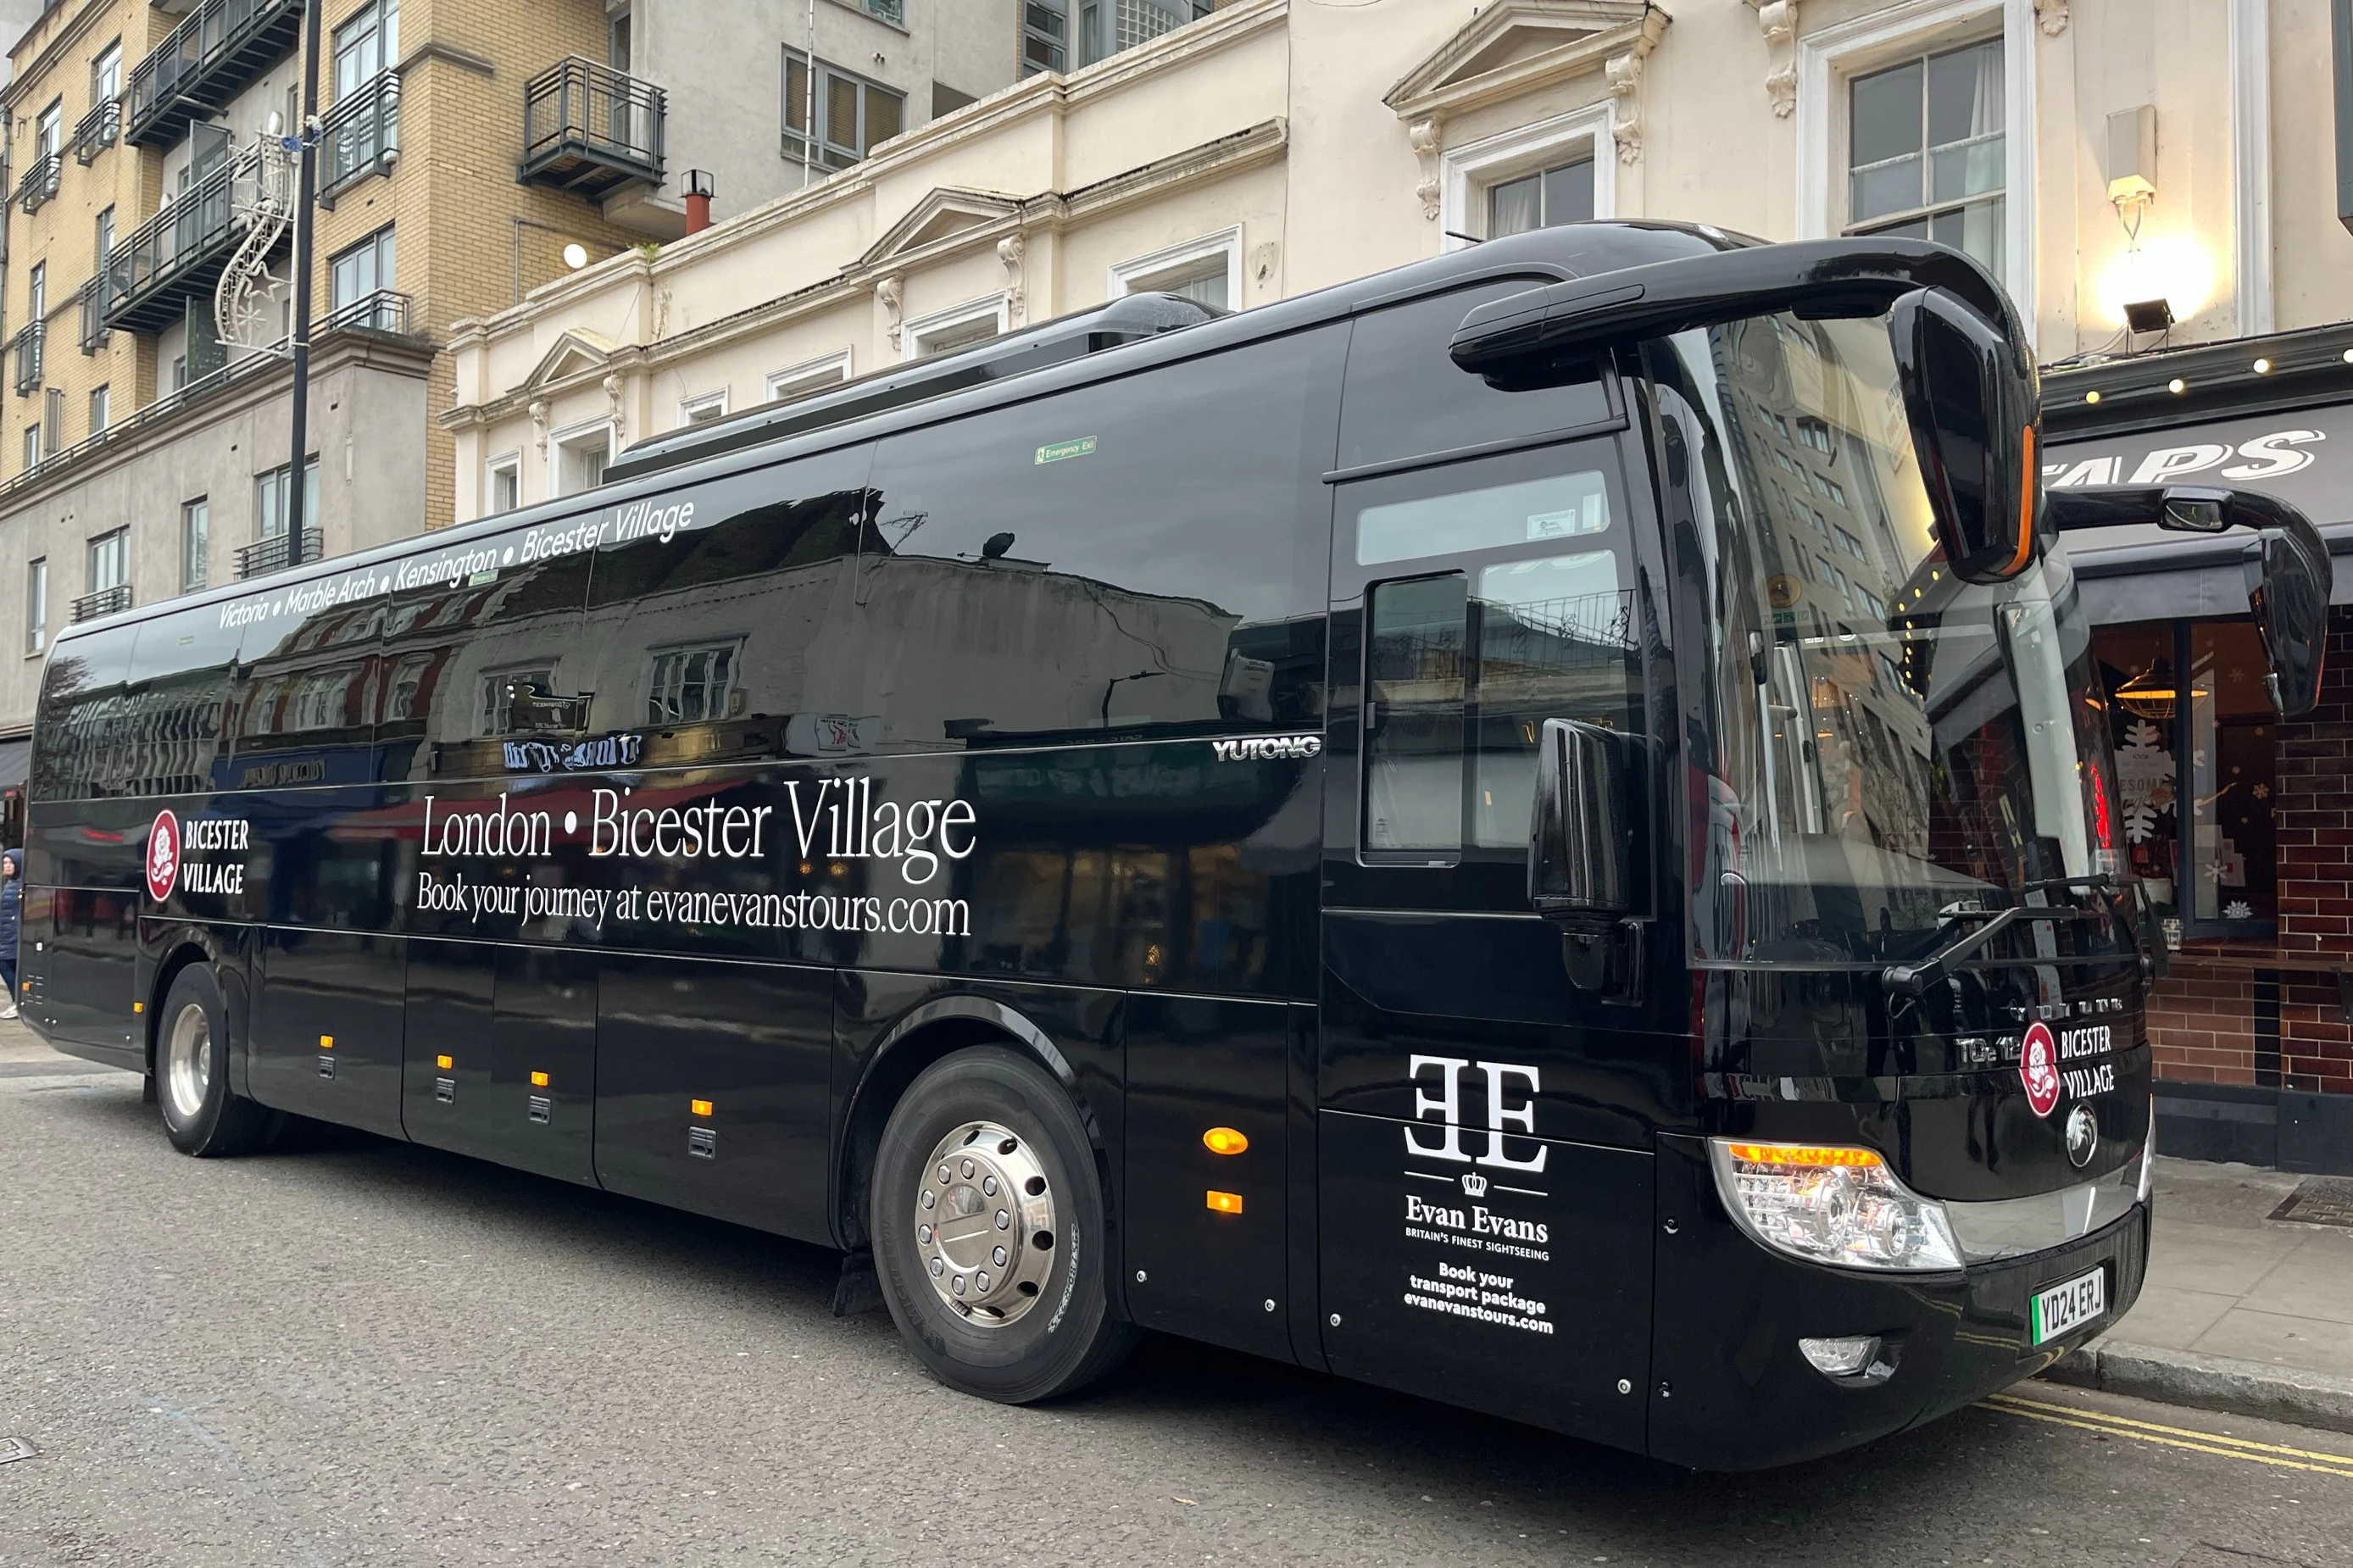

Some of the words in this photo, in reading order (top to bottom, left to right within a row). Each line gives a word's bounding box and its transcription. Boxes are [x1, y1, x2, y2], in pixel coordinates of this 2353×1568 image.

[1045, 445, 1079, 458] Emergency
[220, 597, 268, 629] Victoria
[284, 579, 336, 614] Marble
[337, 570, 375, 602] Arch
[394, 548, 498, 590] Kensington
[520, 520, 609, 563] Bicester
[615, 501, 695, 543] Village
[1212, 736, 1321, 762] YUTONG
[2119, 778, 2166, 792] ESOM
[185, 819, 249, 850] BICESTER
[421, 792, 552, 857] London
[588, 786, 772, 859] Bicester
[783, 776, 976, 885] Village
[183, 863, 245, 895] VILLAGE
[416, 871, 469, 911] Book
[471, 886, 520, 924] your
[521, 874, 612, 931] journey
[616, 884, 642, 921] at
[646, 888, 972, 937] evanevanstours.com
[2061, 1026, 2111, 1059] BICESTER
[2062, 1064, 2115, 1099] VILLAGE
[1405, 1194, 1466, 1230] Evan
[1471, 1205, 1549, 1243] Evans
[1405, 1226, 1449, 1243] BRITAIN'S
[1451, 1235, 1483, 1249] FINEST
[1485, 1241, 1549, 1261] SIGHTSEEING
[1438, 1262, 1477, 1282] Book
[1478, 1272, 1514, 1289] your
[1410, 1275, 1478, 1300] transport
[1482, 1291, 1546, 1315] package
[2042, 1287, 2076, 1333] YD24
[2079, 1275, 2101, 1317] ERJ
[1404, 1293, 1554, 1334] evanevanstours.com
